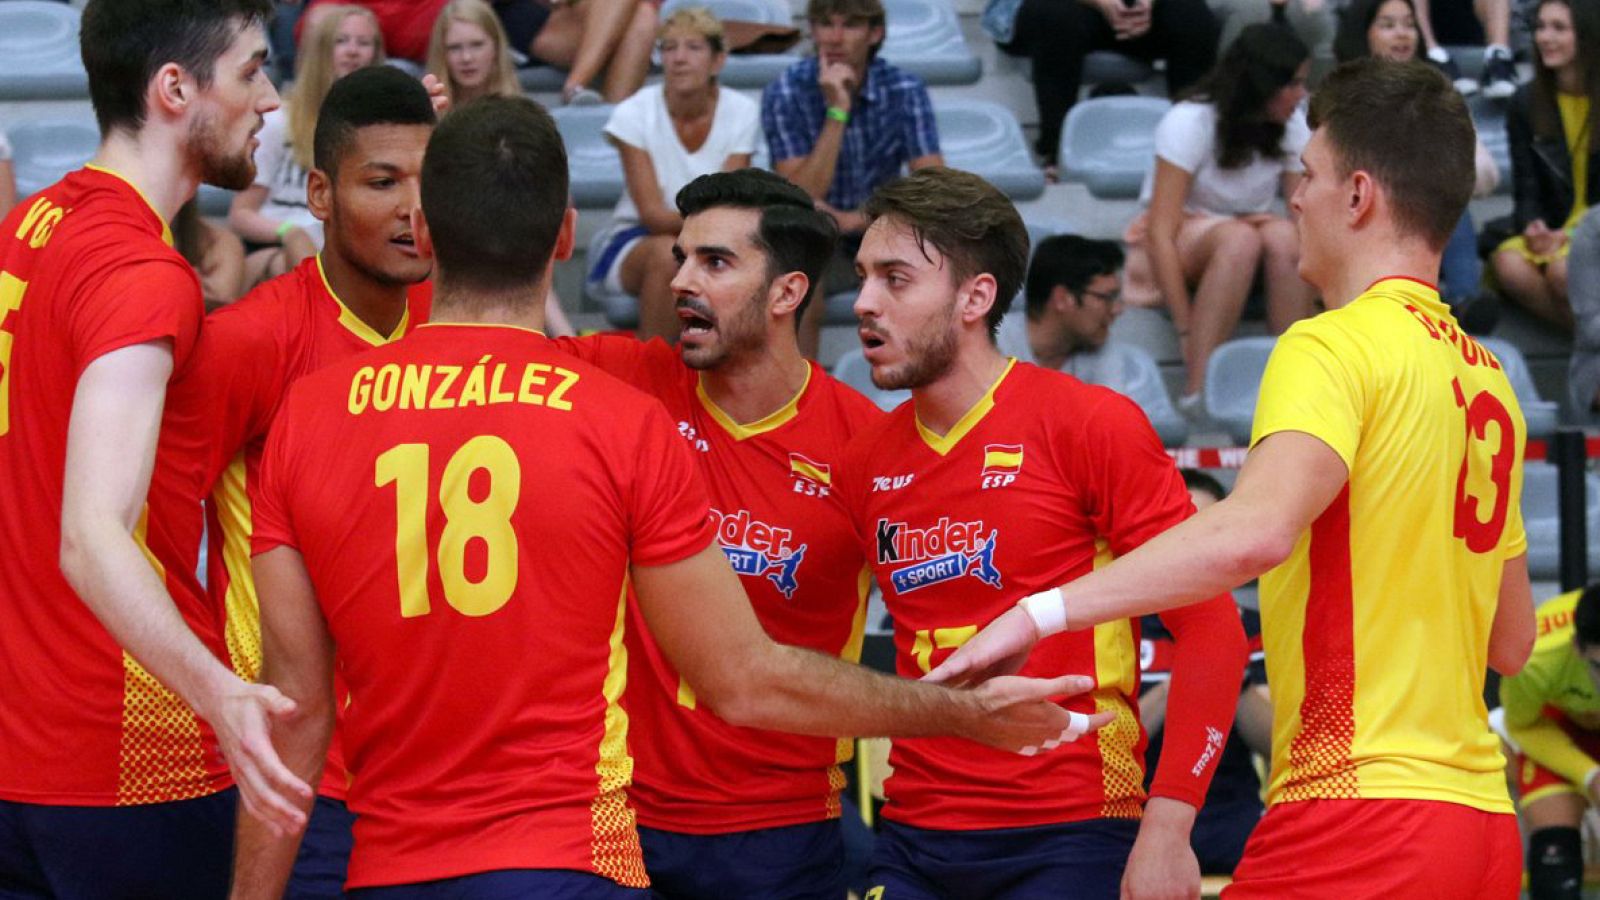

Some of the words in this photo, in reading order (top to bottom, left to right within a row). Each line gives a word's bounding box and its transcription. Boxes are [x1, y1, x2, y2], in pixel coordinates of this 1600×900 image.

[348, 354, 580, 415] GONZÁLEZ
[982, 474, 1016, 490] ESP
[374, 435, 521, 618] 18
